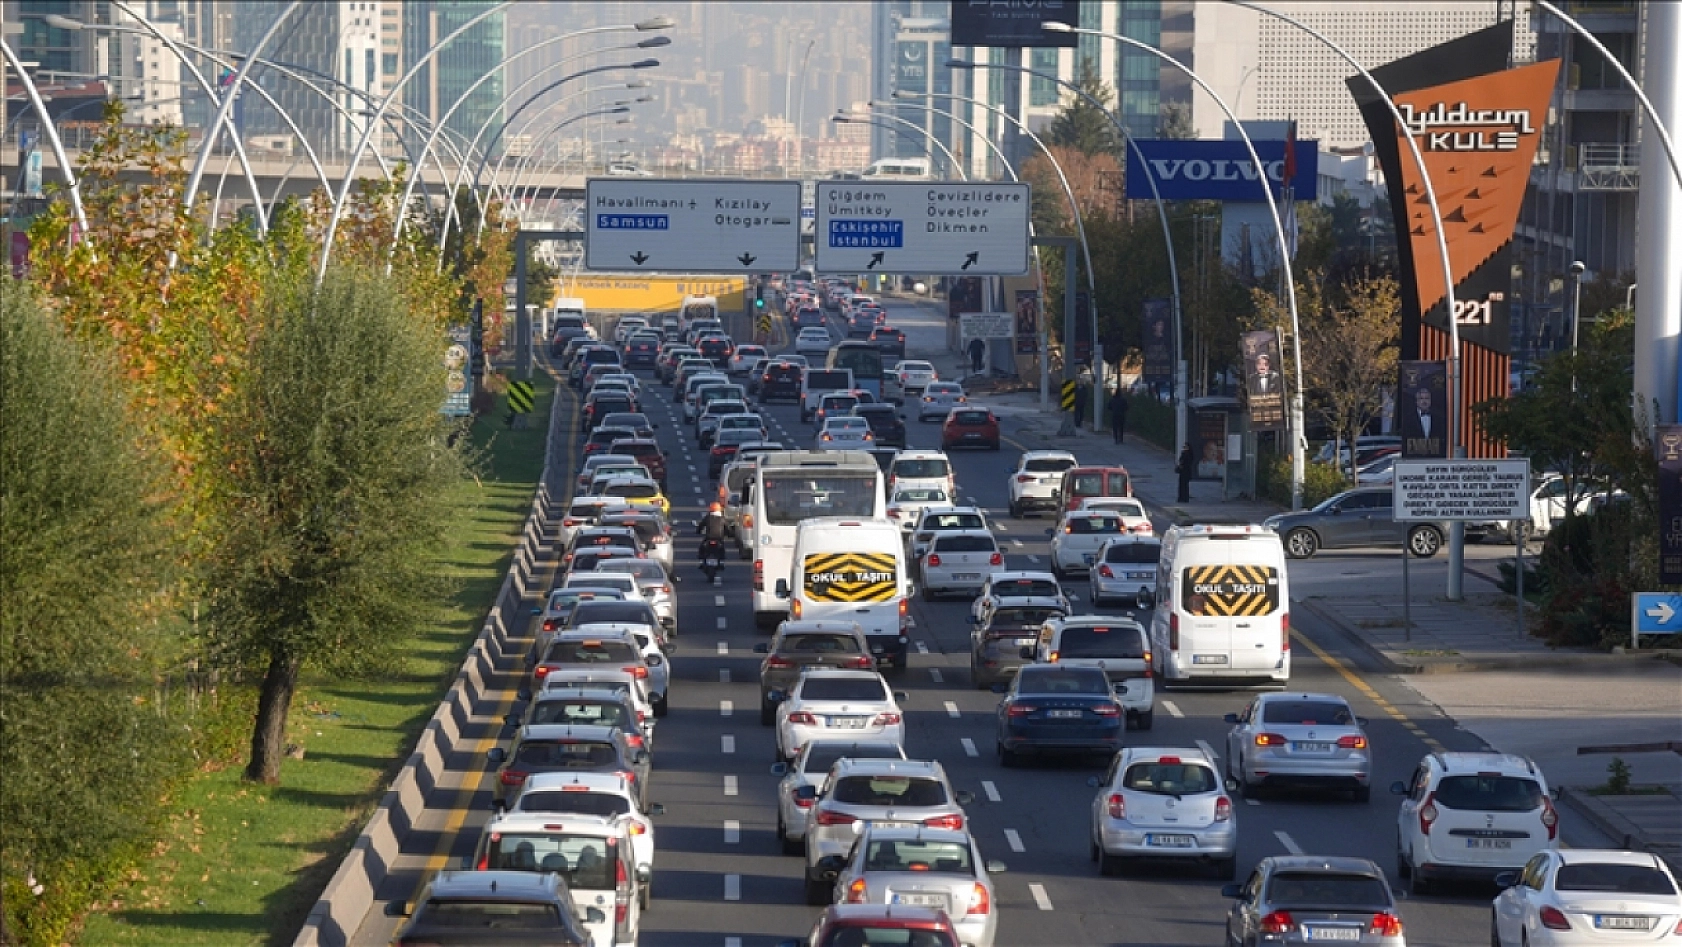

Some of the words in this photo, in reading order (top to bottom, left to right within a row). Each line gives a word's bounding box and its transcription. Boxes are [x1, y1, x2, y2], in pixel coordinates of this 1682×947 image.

[1431, 132, 1518, 149] KULE
[596, 196, 683, 208] Havalimanı
[828, 190, 886, 203] Çiğdem
[715, 199, 771, 211] Kızılay
[828, 203, 892, 217] Ümitköy
[927, 203, 989, 218] Öveçler
[600, 216, 667, 228] Samsun
[715, 215, 770, 228] Otogar
[927, 221, 989, 233] Dikmen
[832, 222, 900, 234] Eskişehir
[1454, 301, 1491, 324] 221
[811, 572, 847, 583] OKUL
[855, 572, 892, 583] TAŞITI
[1193, 584, 1225, 593] OKUL
[1232, 584, 1266, 595] TAŞITI
